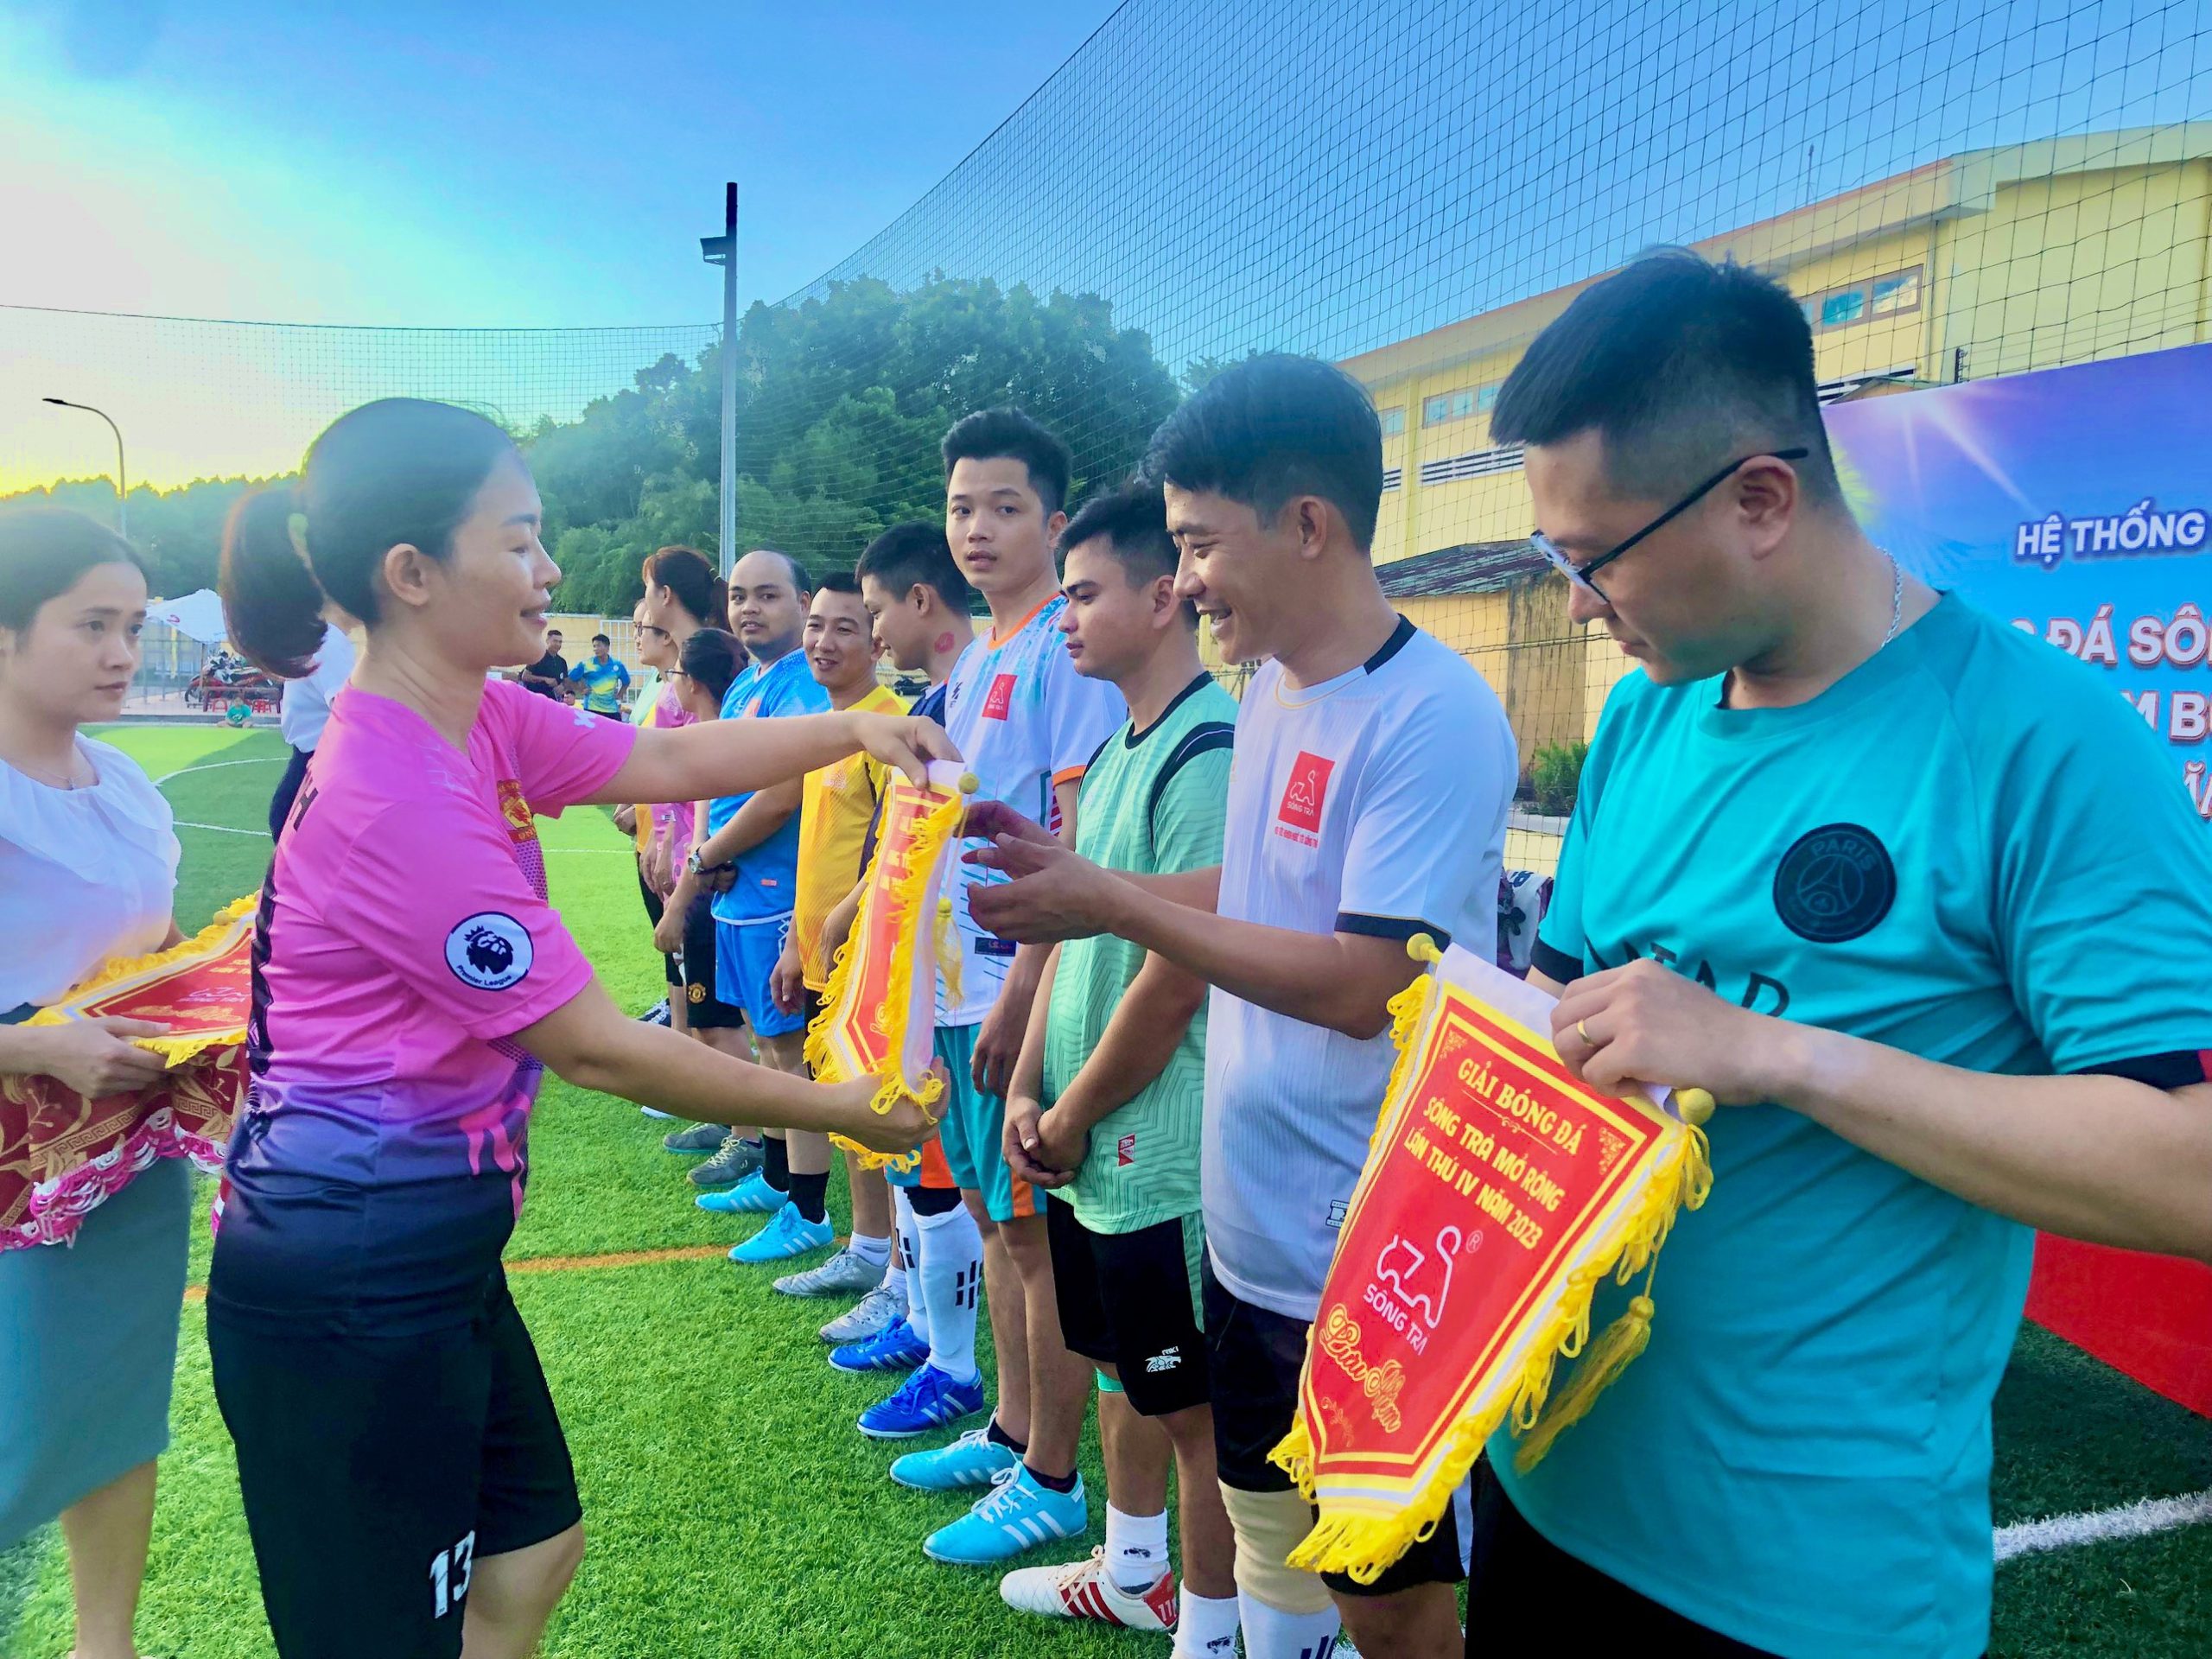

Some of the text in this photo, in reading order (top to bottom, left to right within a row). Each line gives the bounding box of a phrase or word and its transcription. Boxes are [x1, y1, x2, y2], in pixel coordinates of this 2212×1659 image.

[2016, 499, 2206, 563] HỆ THỐNG
[2129, 601, 2212, 665] SÔ
[2169, 690, 2212, 744] B
[1811, 838, 1877, 871] PARIS
[456, 964, 512, 986] Premier League
[1458, 1058, 1587, 1155] GIẢI BÓNG ĐÁ
[1423, 1096, 1461, 1138] SÔNG
[1520, 1166, 1566, 1212] RỘNG
[1454, 1168, 1480, 1198] IV
[1474, 1183, 1515, 1225] NĂM
[1505, 1209, 1544, 1250] 2023
[1363, 1283, 1408, 1332] SÔNG
[429, 1529, 475, 1620] 13
